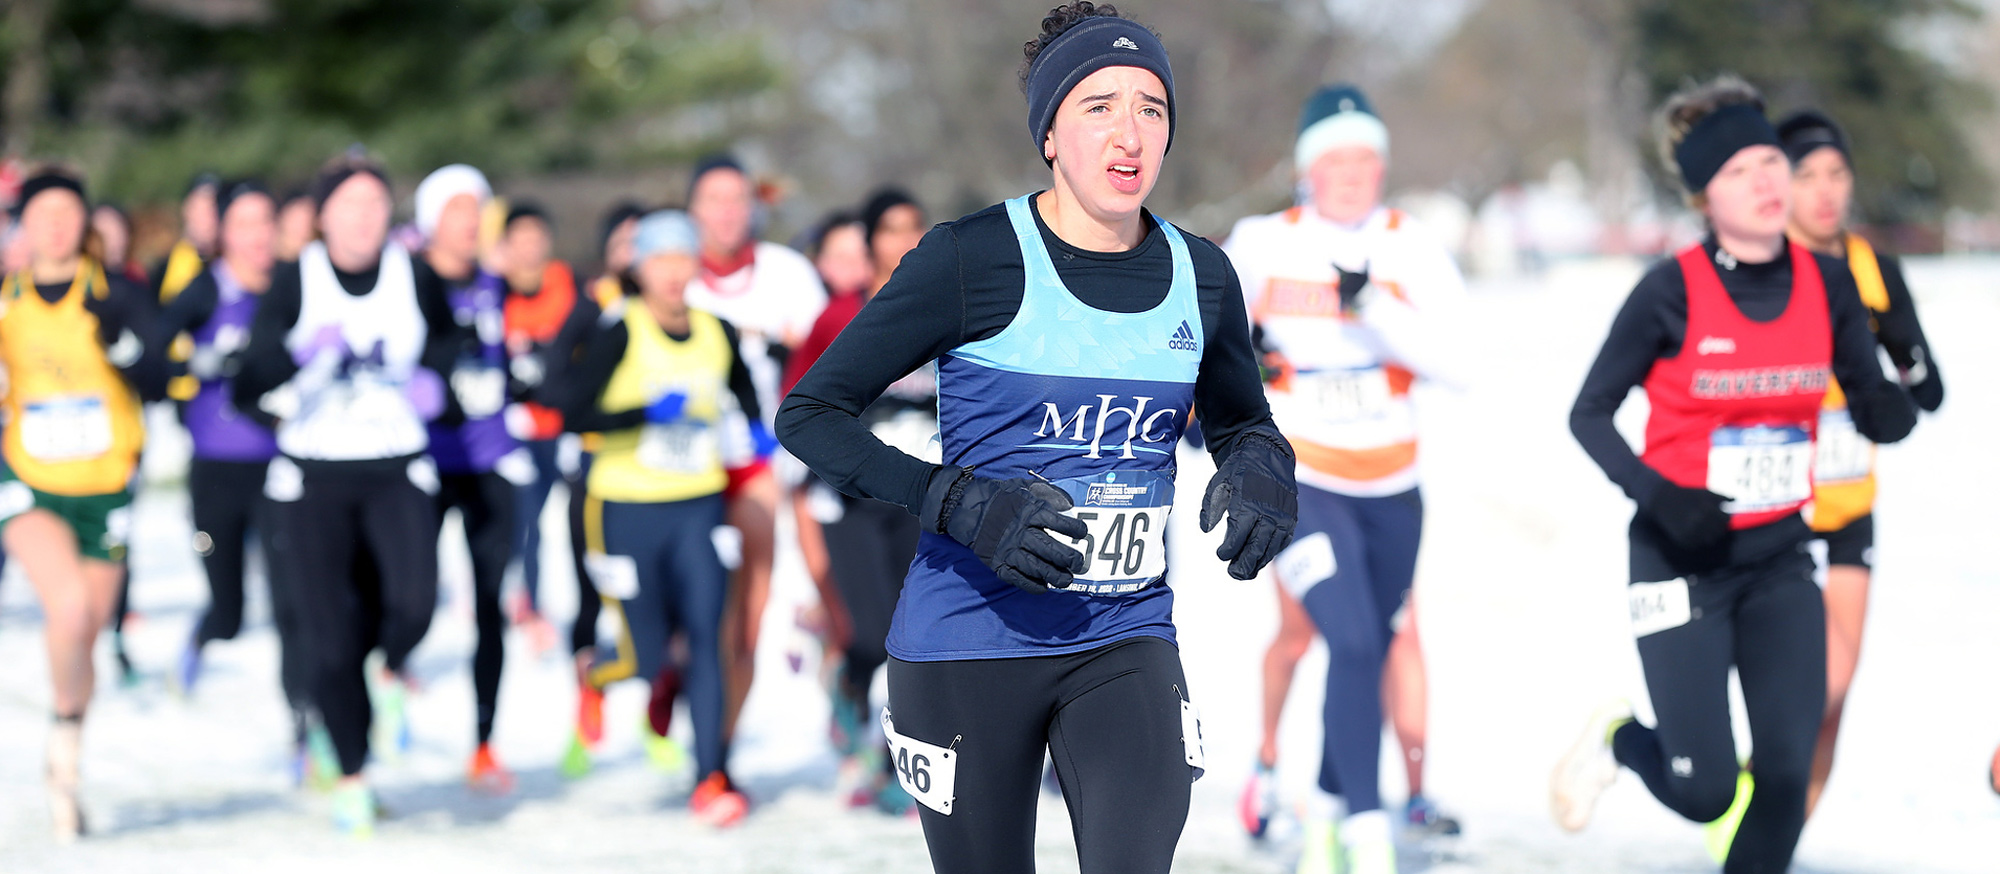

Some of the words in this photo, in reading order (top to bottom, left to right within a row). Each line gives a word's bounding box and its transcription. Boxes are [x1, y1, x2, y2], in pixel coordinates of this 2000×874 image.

[1168, 338, 1198, 352] adidas
[1033, 394, 1178, 459] MHC
[1736, 452, 1793, 500] 484
[1071, 511, 1150, 576] 546
